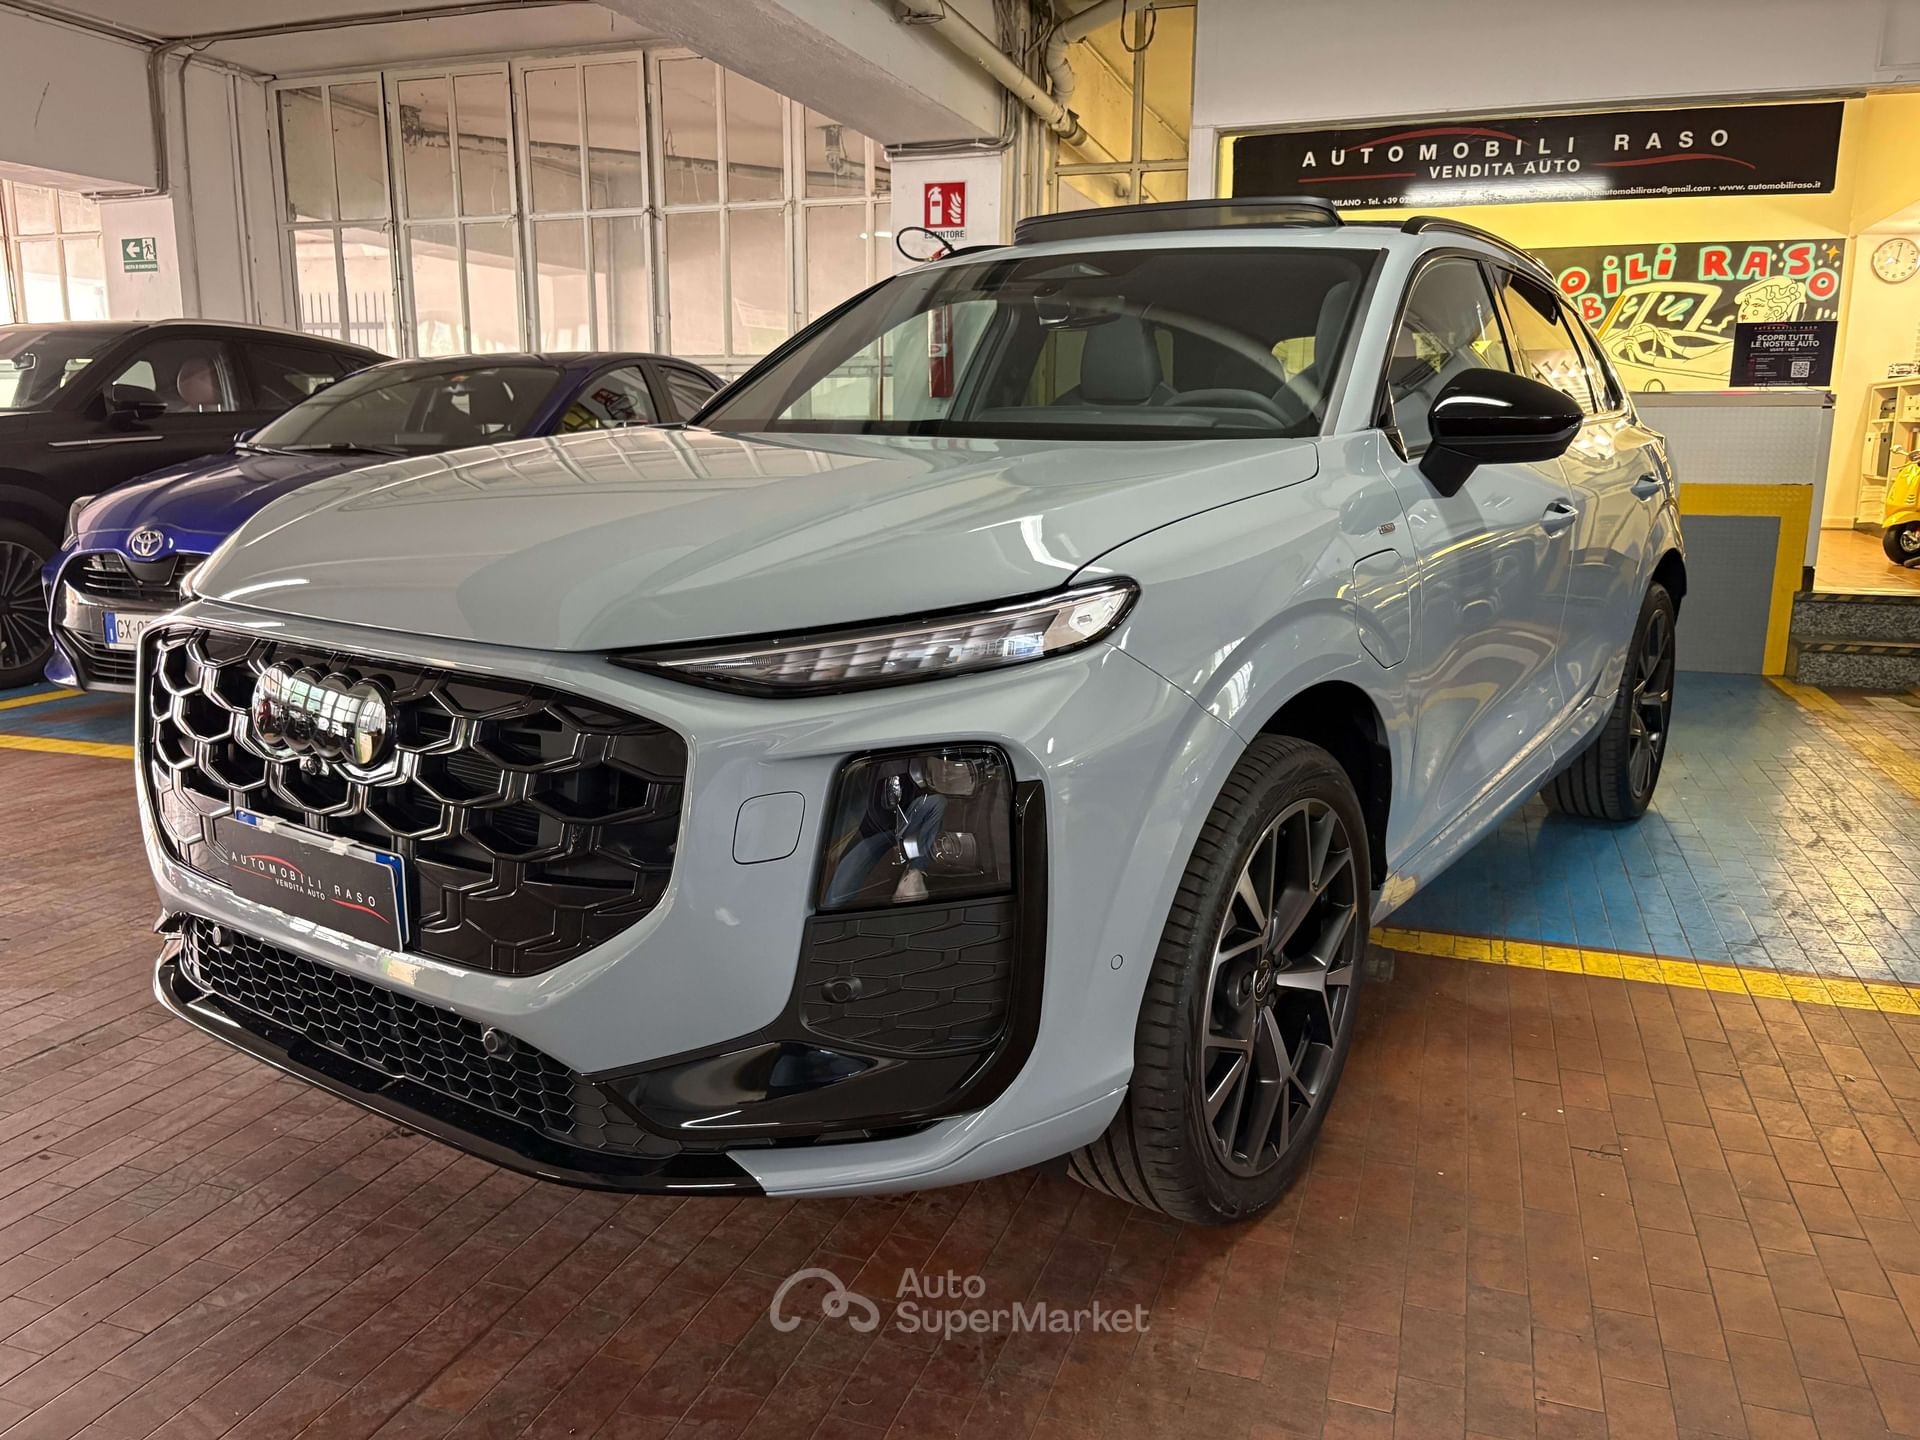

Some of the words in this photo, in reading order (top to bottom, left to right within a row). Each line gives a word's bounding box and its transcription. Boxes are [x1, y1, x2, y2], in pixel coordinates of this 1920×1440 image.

[1302, 136, 1574, 168] AUTOMOBILI
[1614, 129, 1730, 152] RASO
[1429, 162, 1515, 180] VENDITA
[1523, 158, 1581, 175] AUTO
[1747, 180, 1822, 190] automobiliraso.it
[1331, 198, 1362, 208] MILANO
[1367, 197, 1381, 206] Tel.
[1382, 196, 1398, 205] +39
[924, 230, 965, 239] EINTORE
[1699, 242, 1840, 300] RASO
[1756, 333, 1787, 341] SCOPRI
[1787, 333, 1814, 341] TUTTE
[1762, 340, 1796, 349] NOSTRE
[1796, 339, 1820, 347] AUTO
[231, 852, 322, 890] AUTOMOBILI
[334, 884, 376, 907] RASO
[275, 878, 305, 893] VENDITA
[307, 889, 326, 901] AUTO
